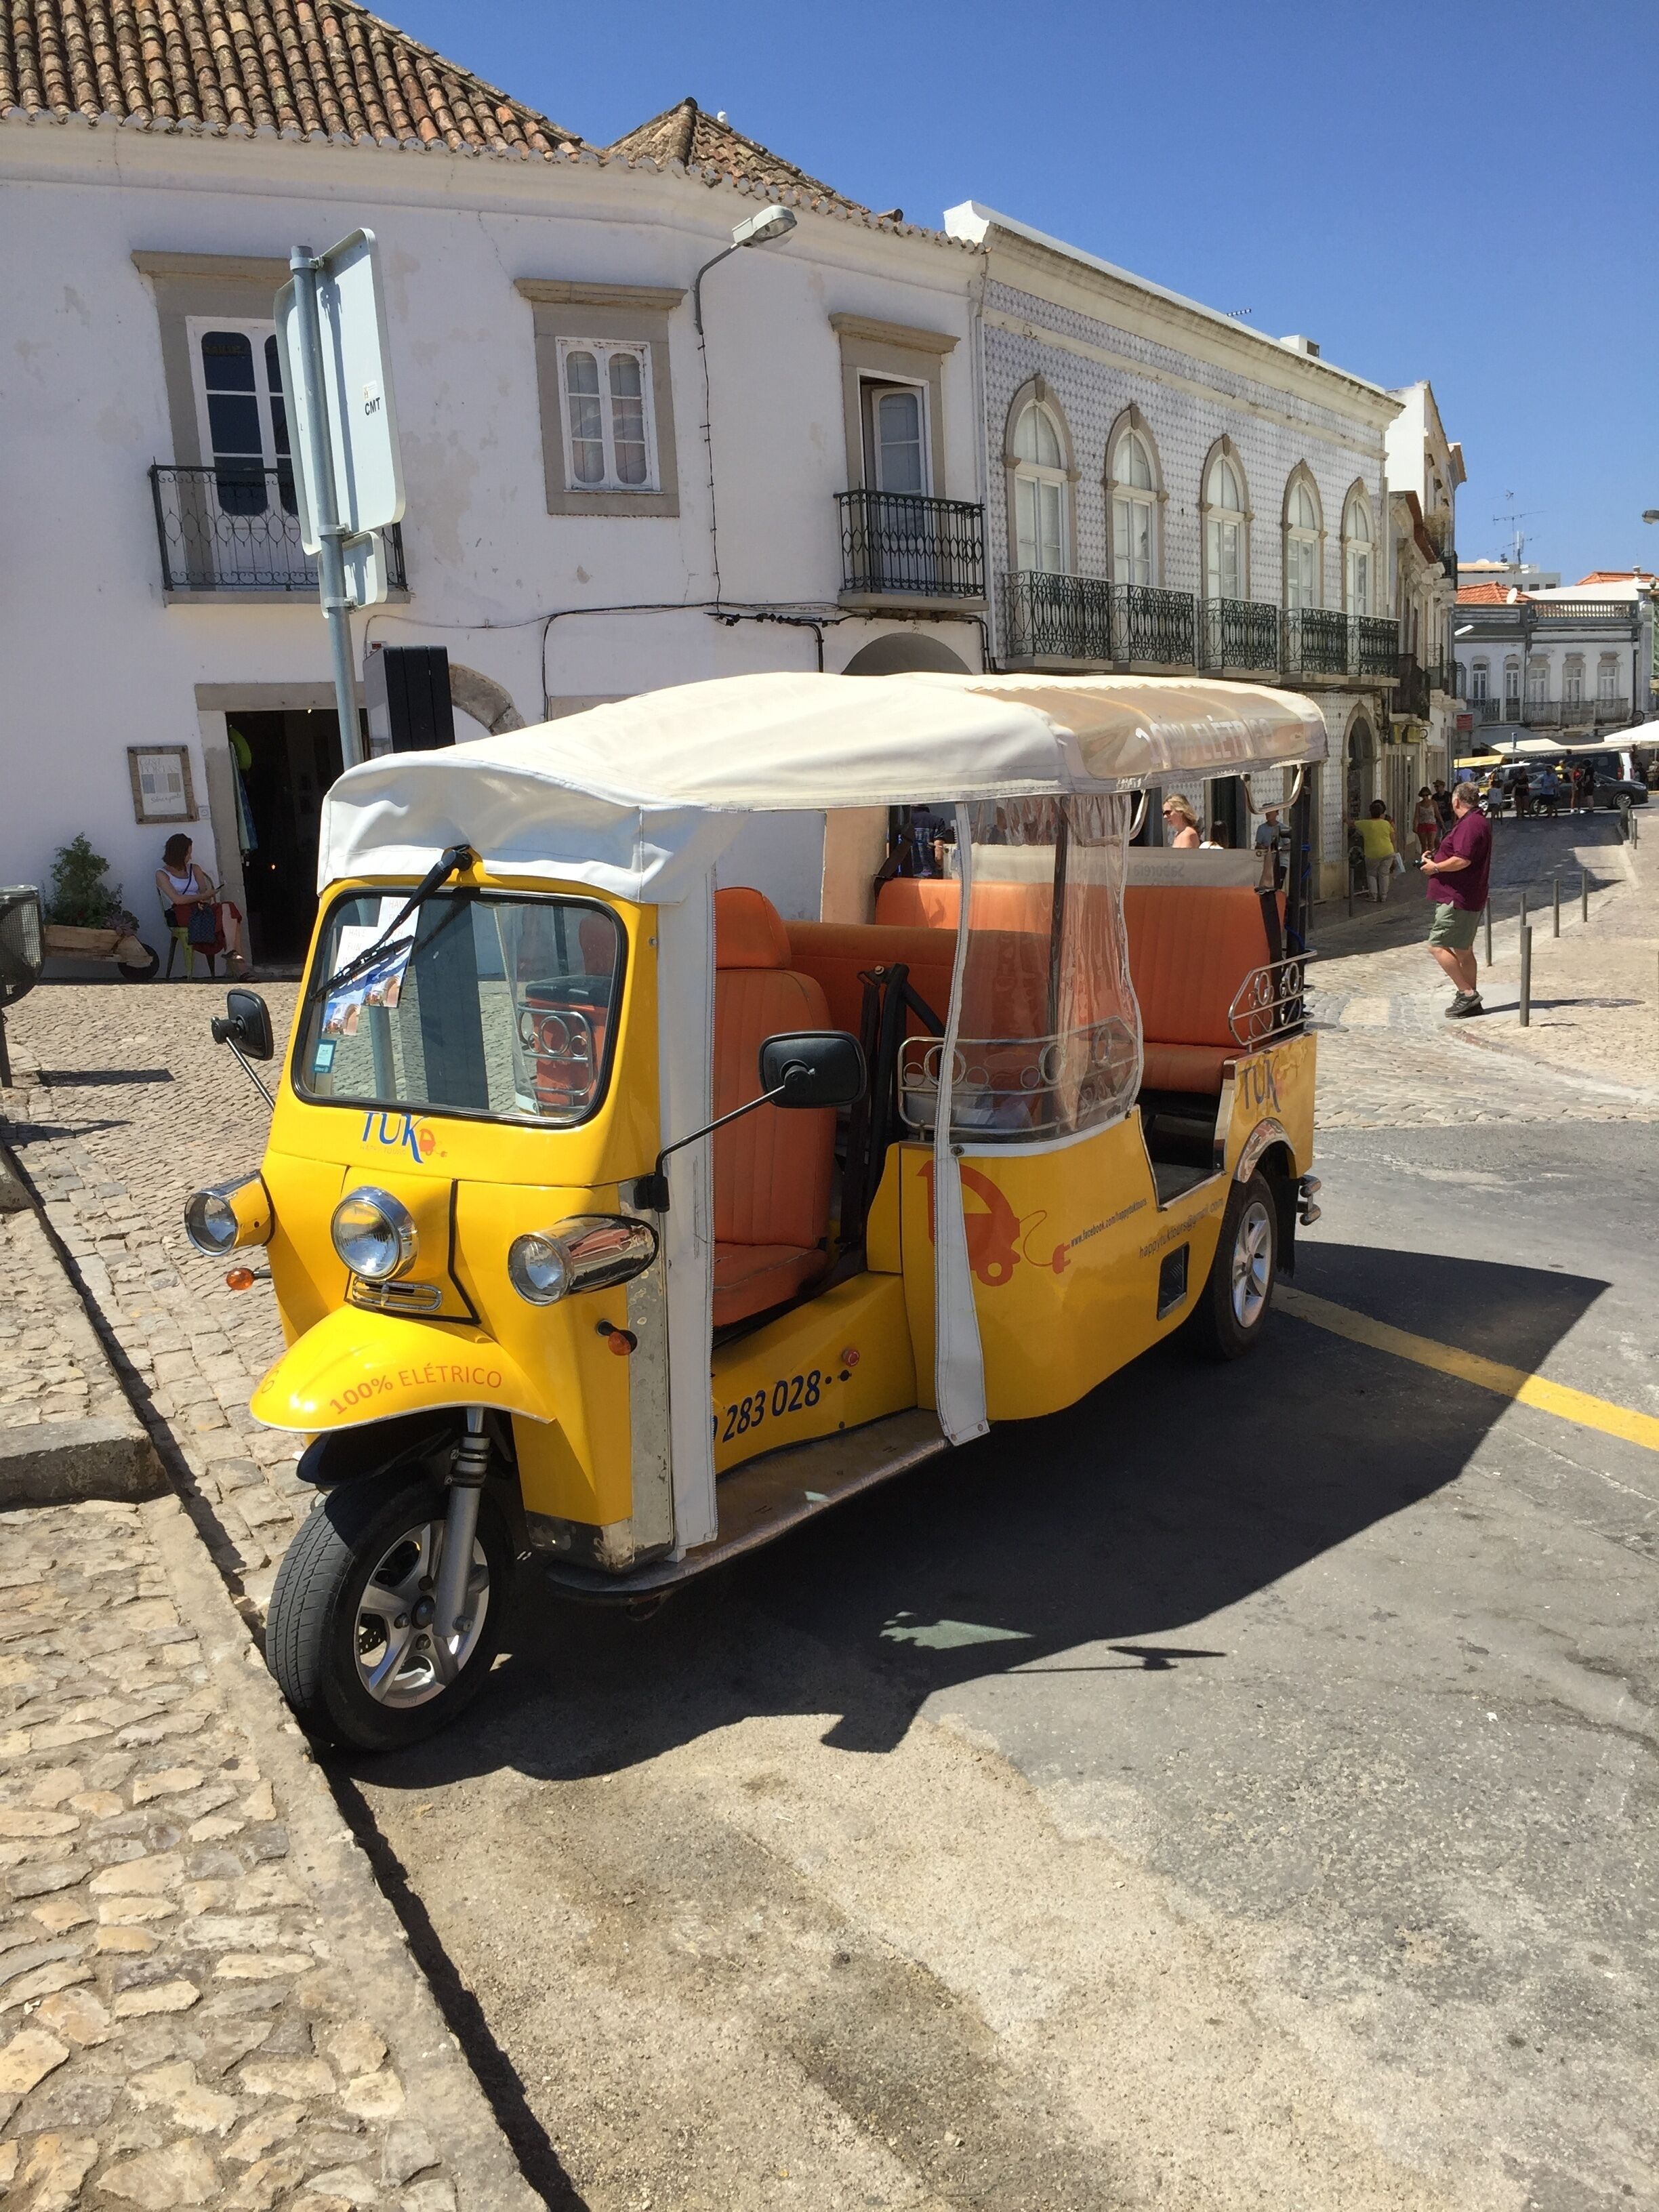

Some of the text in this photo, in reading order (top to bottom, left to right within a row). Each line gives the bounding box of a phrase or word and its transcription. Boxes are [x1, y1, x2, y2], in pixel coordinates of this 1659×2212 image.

[365, 396, 381, 416] CMT
[389, 899, 408, 909] HAV
[1239, 1056, 1282, 1113] TUK
[362, 1111, 430, 1164] TUK
[329, 1362, 502, 1415] 100% ELÉTRICO
[722, 1389, 766, 1443] 283
[771, 1369, 821, 1416] 028
